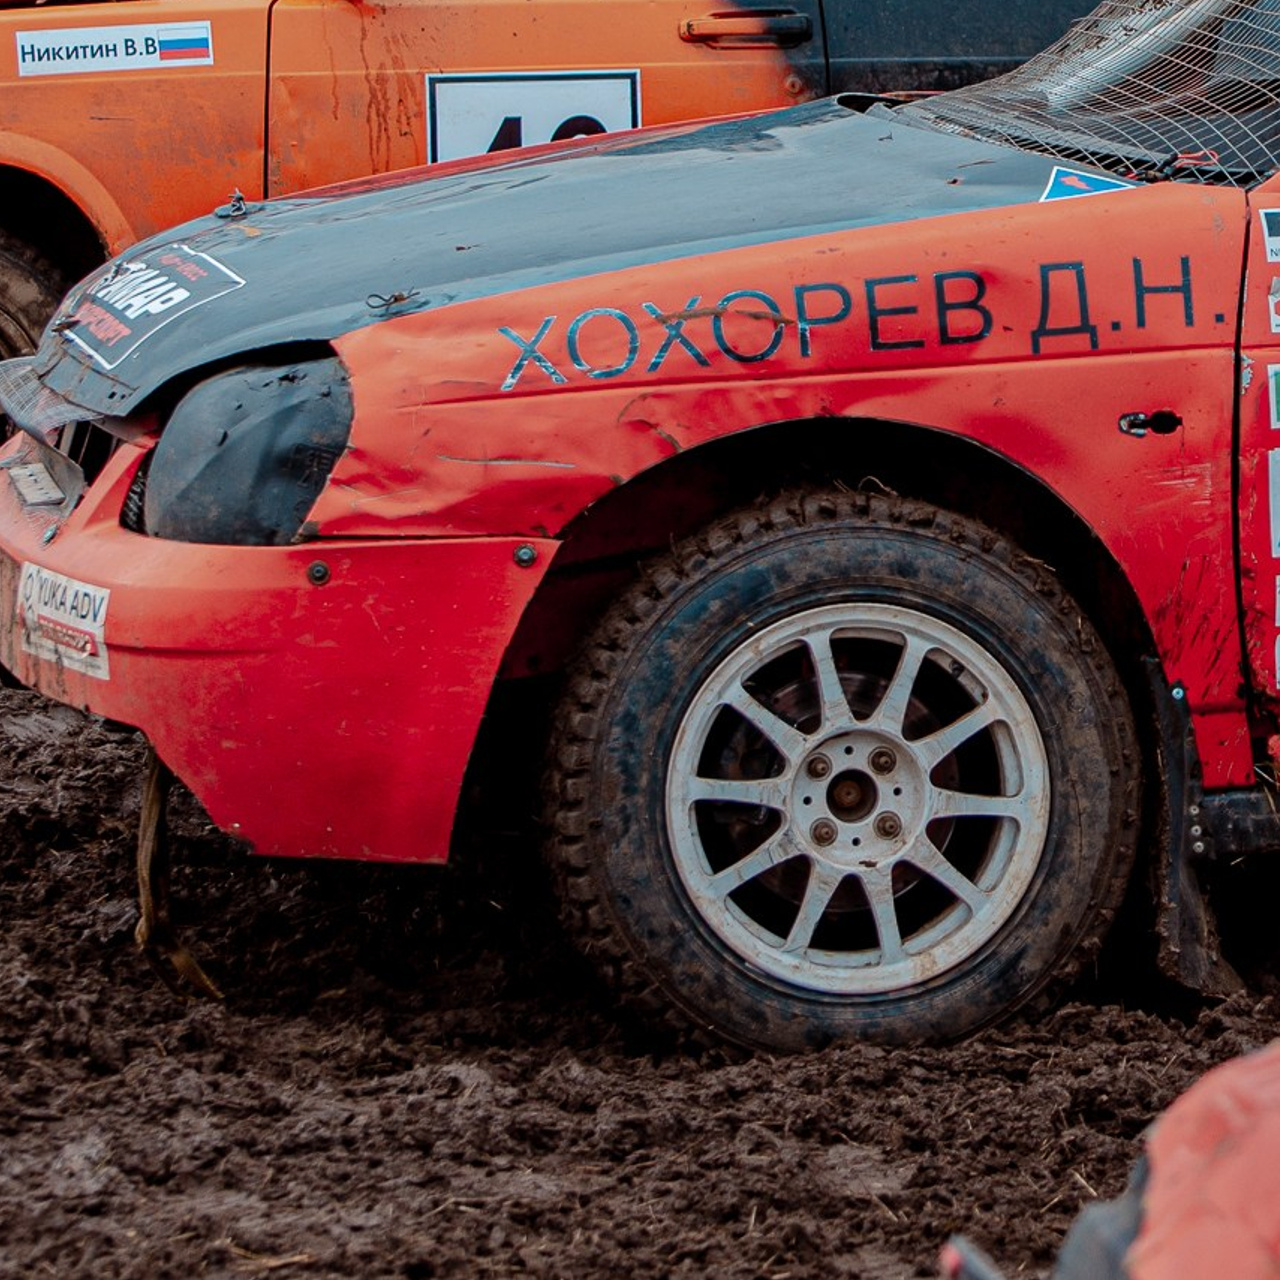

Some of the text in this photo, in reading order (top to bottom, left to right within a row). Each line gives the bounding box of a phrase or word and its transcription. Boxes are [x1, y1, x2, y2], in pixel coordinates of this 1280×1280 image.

[21, 43, 118, 64] Никитин
[499, 255, 1225, 392] ХОХОРЕВ Д.Н.
[38, 575, 105, 623] YUKA ADV
